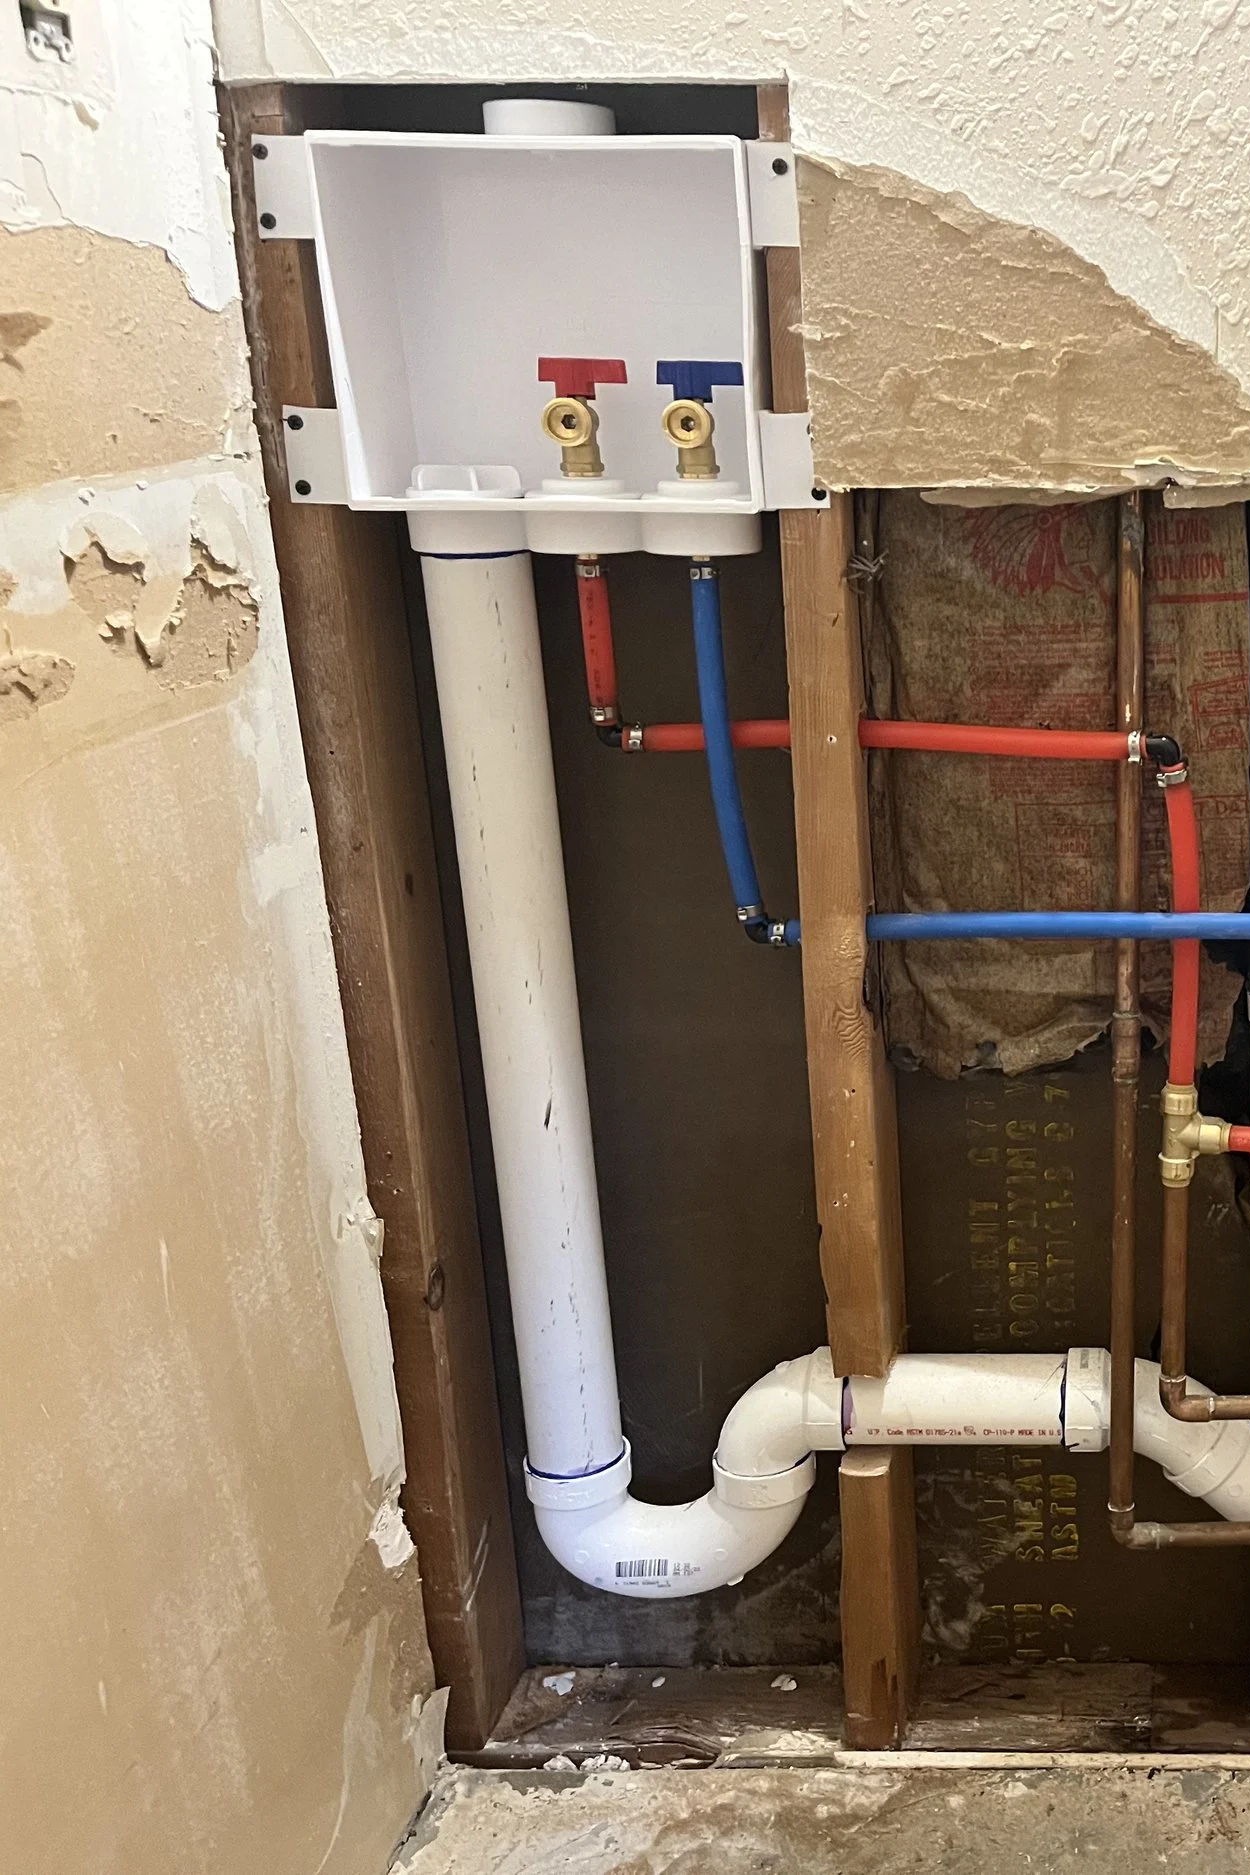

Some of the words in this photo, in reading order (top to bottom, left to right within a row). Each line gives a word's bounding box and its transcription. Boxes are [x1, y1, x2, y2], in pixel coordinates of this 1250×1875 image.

[1004, 1118, 1040, 1338] COMPLYING
[1017, 1428, 1034, 1436] MADE
[1038, 1428, 1046, 1436] IN
